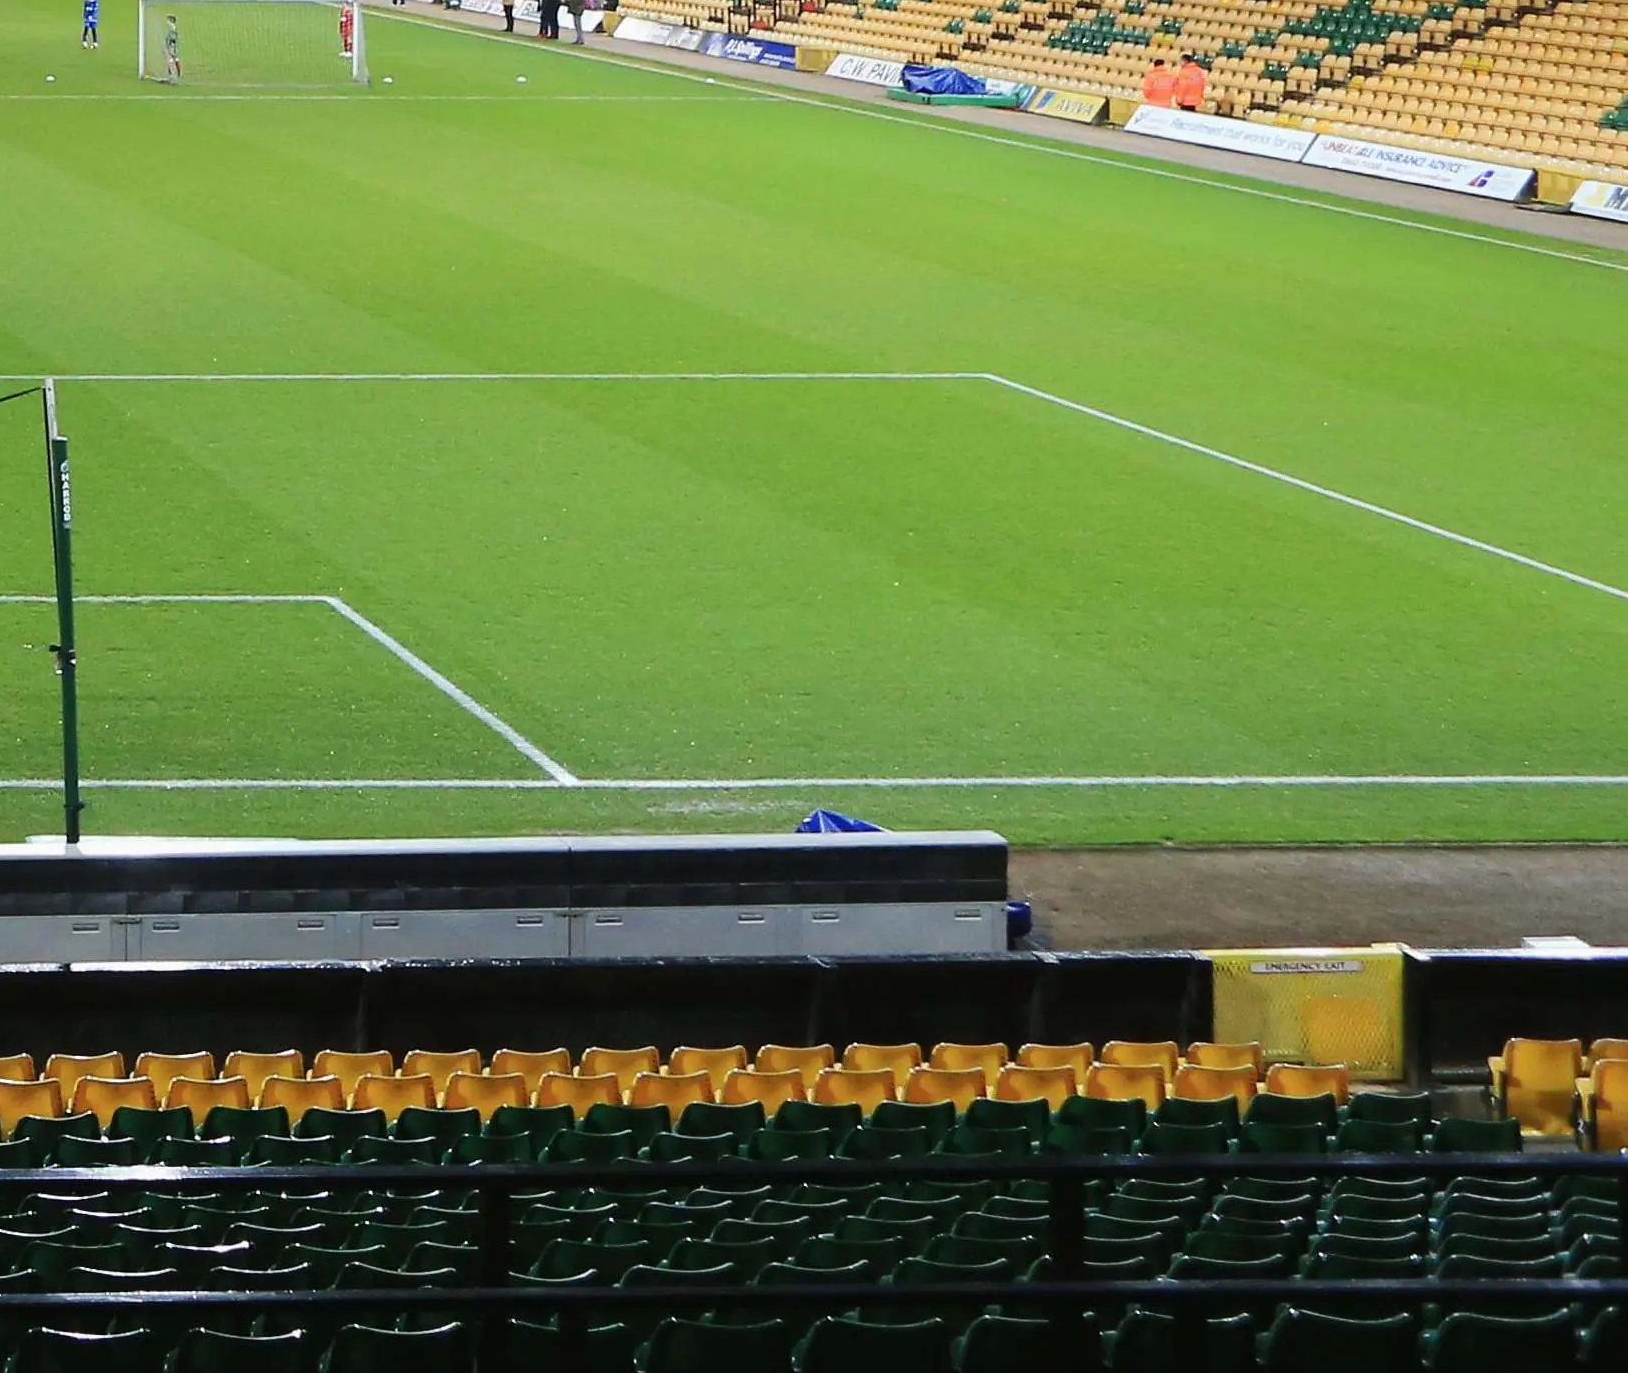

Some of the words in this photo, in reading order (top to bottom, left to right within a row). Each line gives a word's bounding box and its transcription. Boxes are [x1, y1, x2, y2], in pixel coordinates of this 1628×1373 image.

[1376, 147, 1425, 168] INSURANCE
[61, 473, 71, 521] HARROD
[1265, 961, 1320, 971] EMERGENCY
[1324, 961, 1346, 971] EXIT
